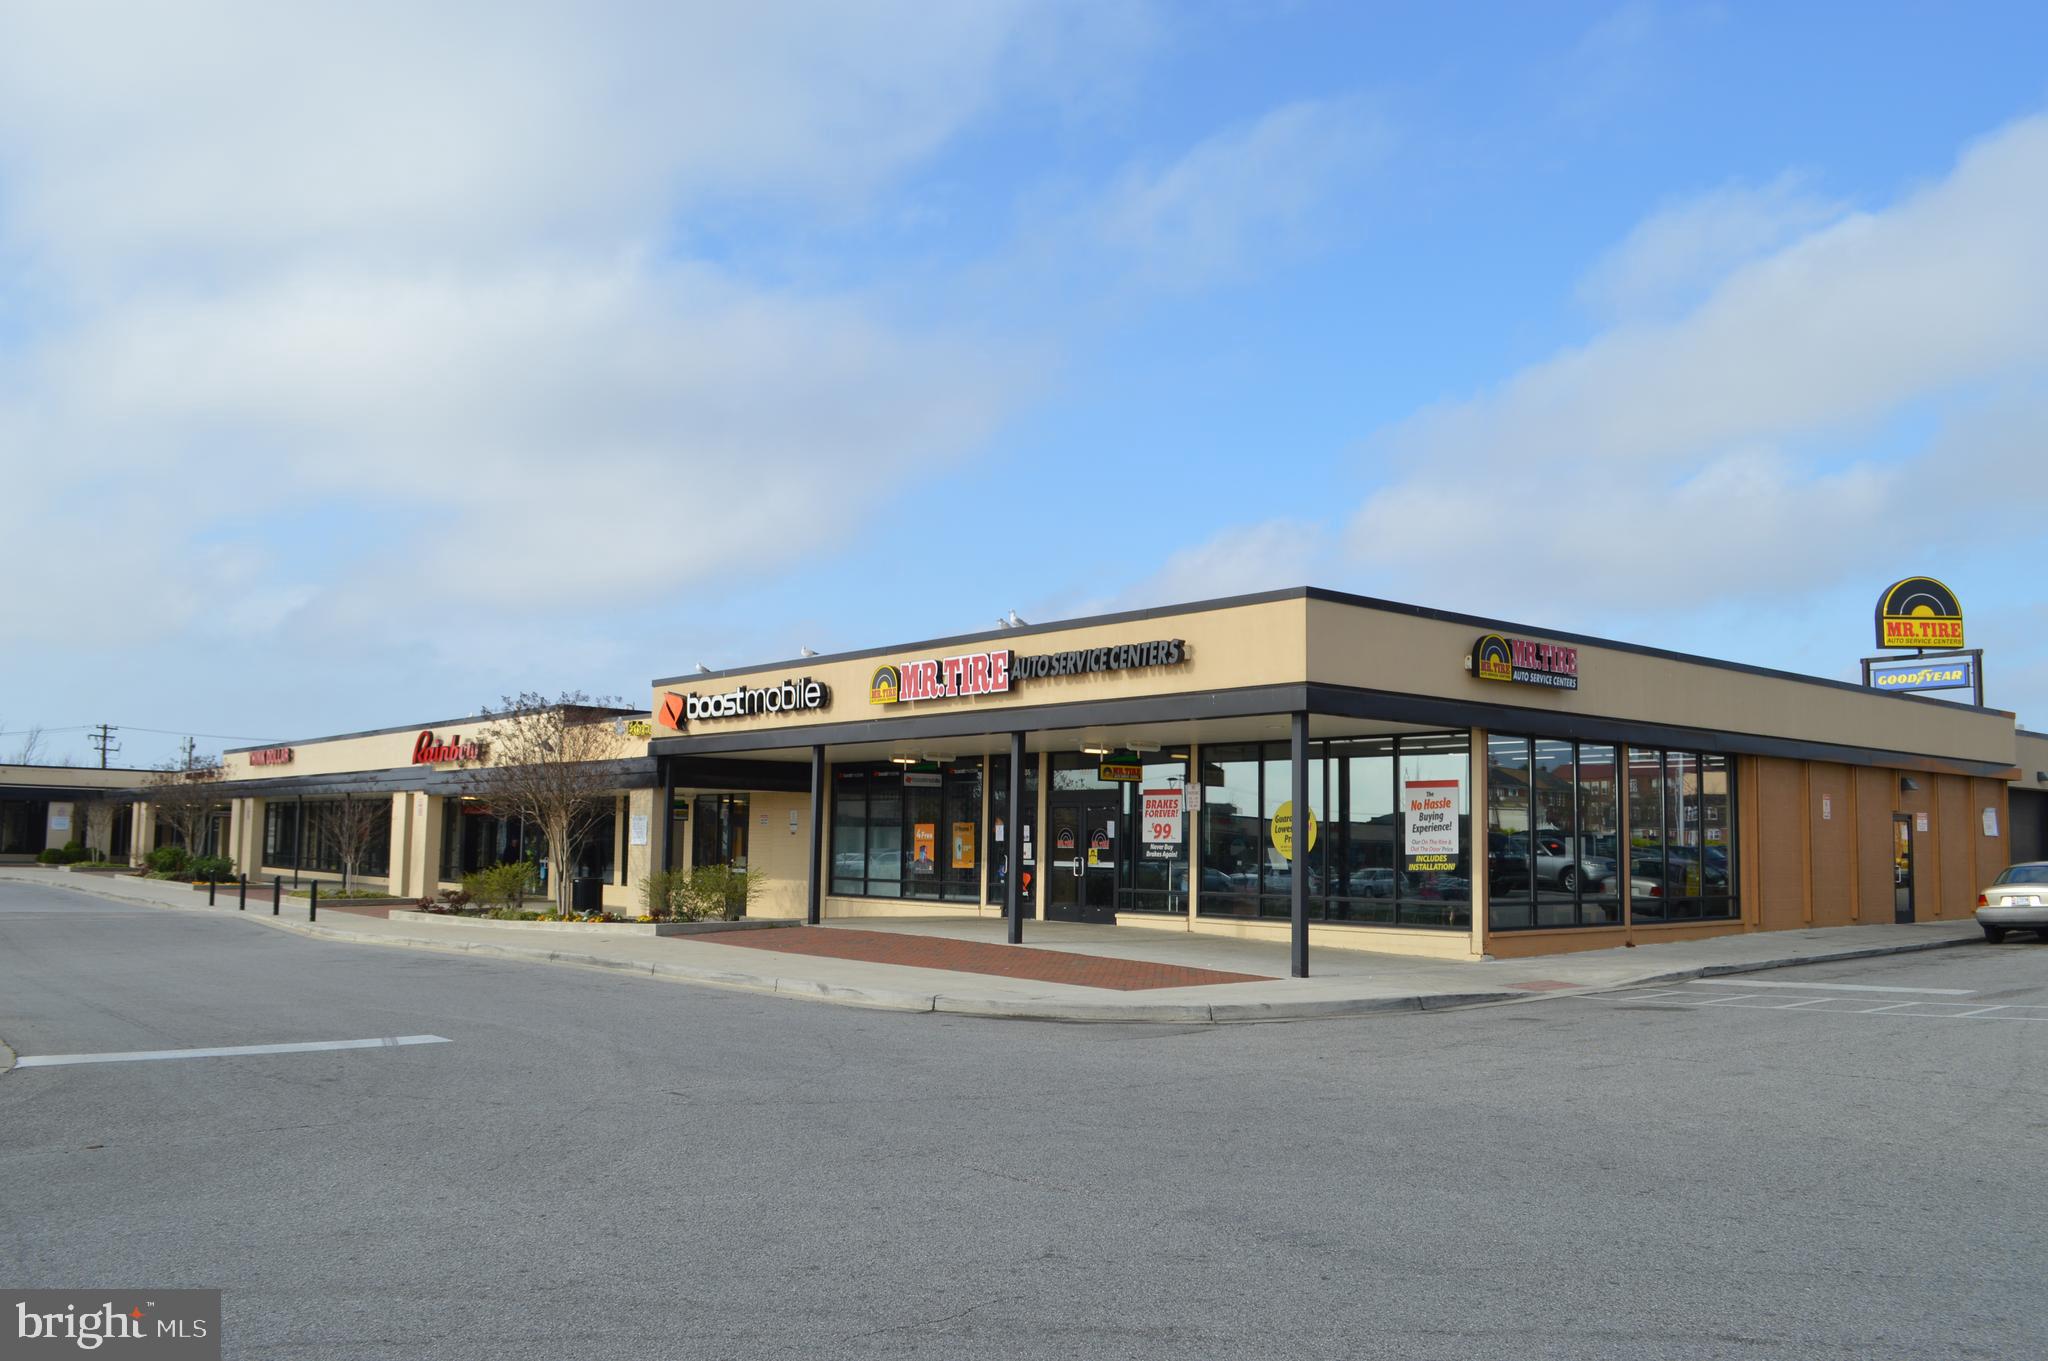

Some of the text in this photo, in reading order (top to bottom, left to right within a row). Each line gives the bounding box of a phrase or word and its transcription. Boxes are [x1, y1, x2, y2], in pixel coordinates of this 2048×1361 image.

[1011, 639, 1180, 680] AUTO SERVICE CENTERS
[1513, 671, 1529, 682] AUTO
[1530, 673, 1552, 685] SERVICE
[1553, 676, 1577, 688] CENTERS
[1877, 670, 1963, 685] GOODYEAR
[412, 730, 479, 764] Rainbow
[1146, 799, 1178, 809] BRAKES
[1410, 797, 1452, 811] No Hassle
[1145, 809, 1178, 818] FOREVER!
[1419, 812, 1444, 823] Buying
[1412, 821, 1452, 834] Experience!
[1408, 863, 1456, 871] INSTALLATION!
